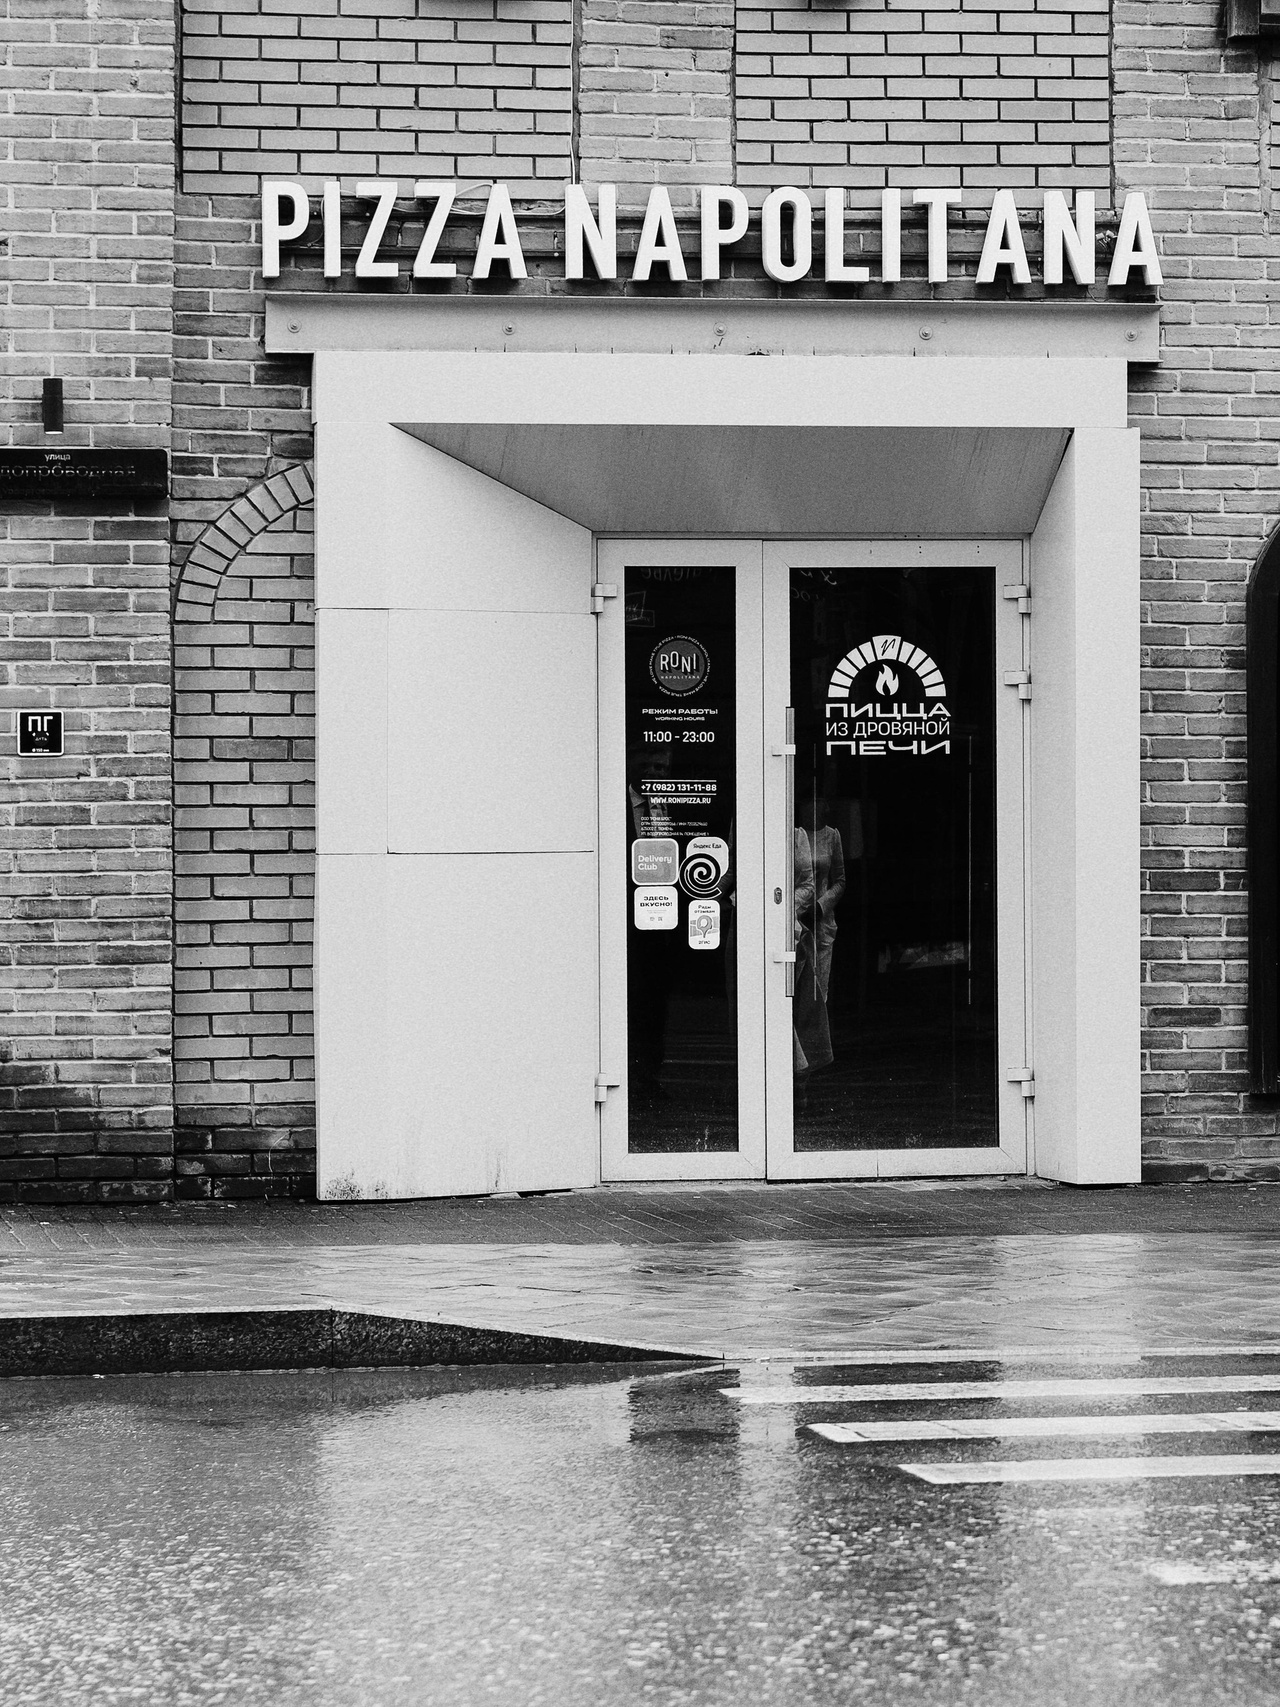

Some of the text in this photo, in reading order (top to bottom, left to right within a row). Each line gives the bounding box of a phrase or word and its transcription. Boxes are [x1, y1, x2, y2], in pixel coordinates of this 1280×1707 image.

[261, 181, 1165, 286] PIZZA NAPOLITANA
[45, 454, 71, 462] улица
[660, 651, 697, 673] RONI
[825, 702, 952, 720] ПИЦЦА
[28, 716, 53, 732] ПГ
[826, 717, 950, 739] ИЗ ДРОВЯНОЙ
[643, 731, 672, 742] 11:00
[682, 731, 715, 742] 23:00
[826, 740, 951, 756] ПЕЧИ
[652, 783, 675, 791] (982)
[638, 855, 672, 864] Delivery
